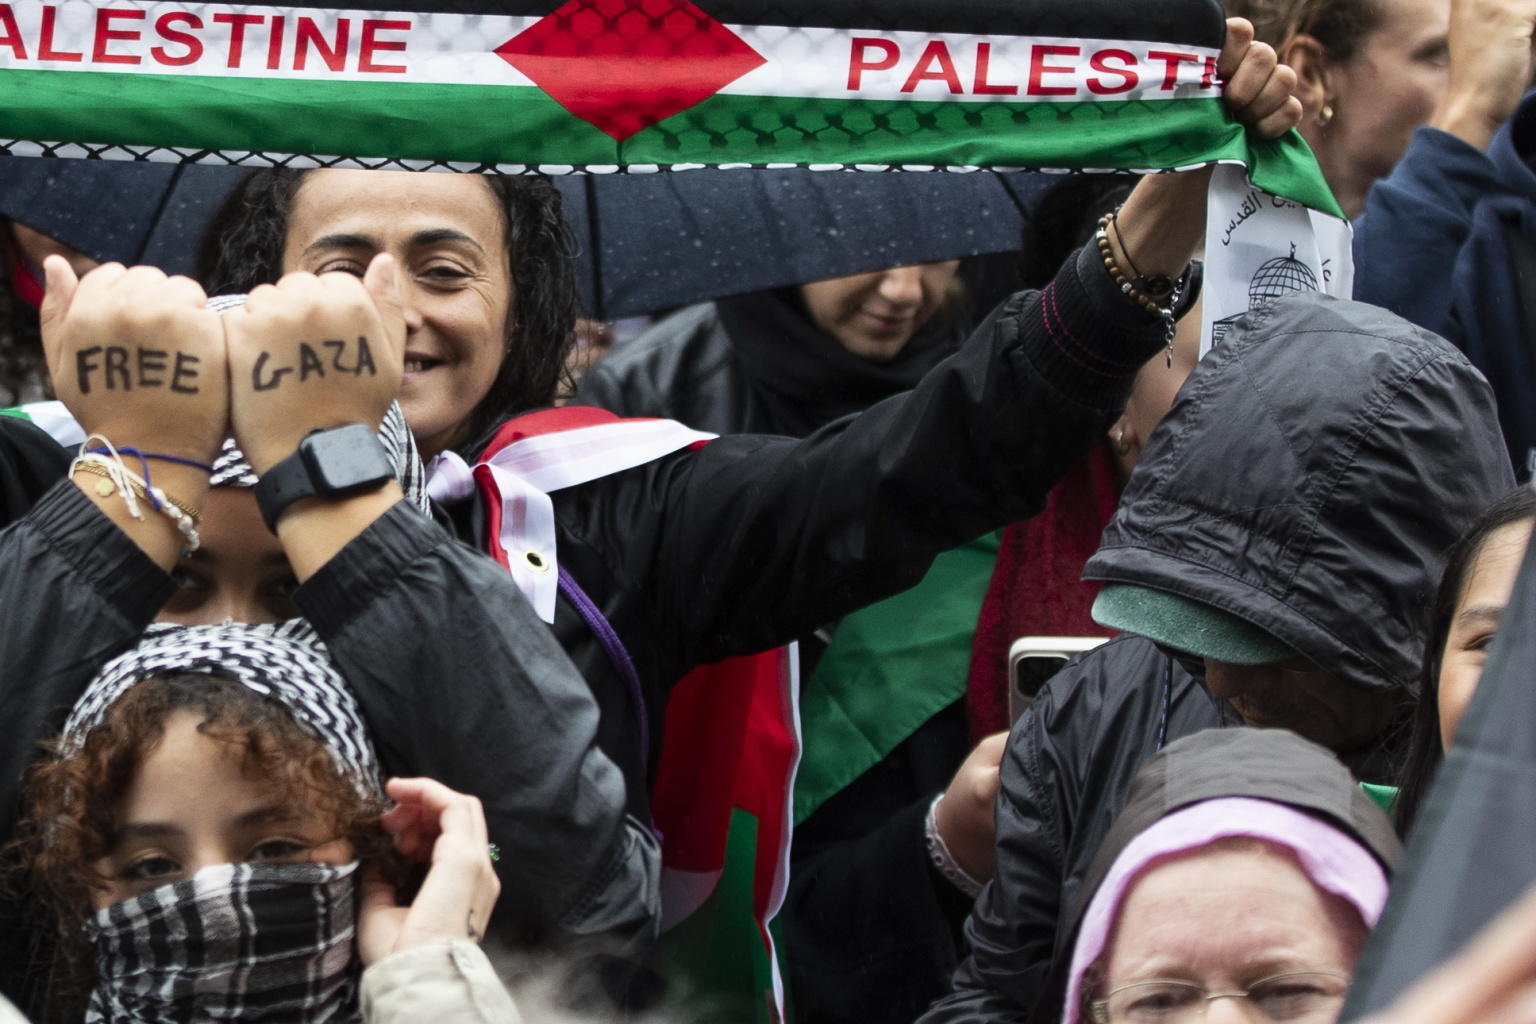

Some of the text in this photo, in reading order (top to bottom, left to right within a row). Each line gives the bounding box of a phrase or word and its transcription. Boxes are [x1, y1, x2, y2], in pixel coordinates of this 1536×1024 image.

[1221, 191, 1263, 246] القدس
[76, 336, 377, 395] FREE GAZA
